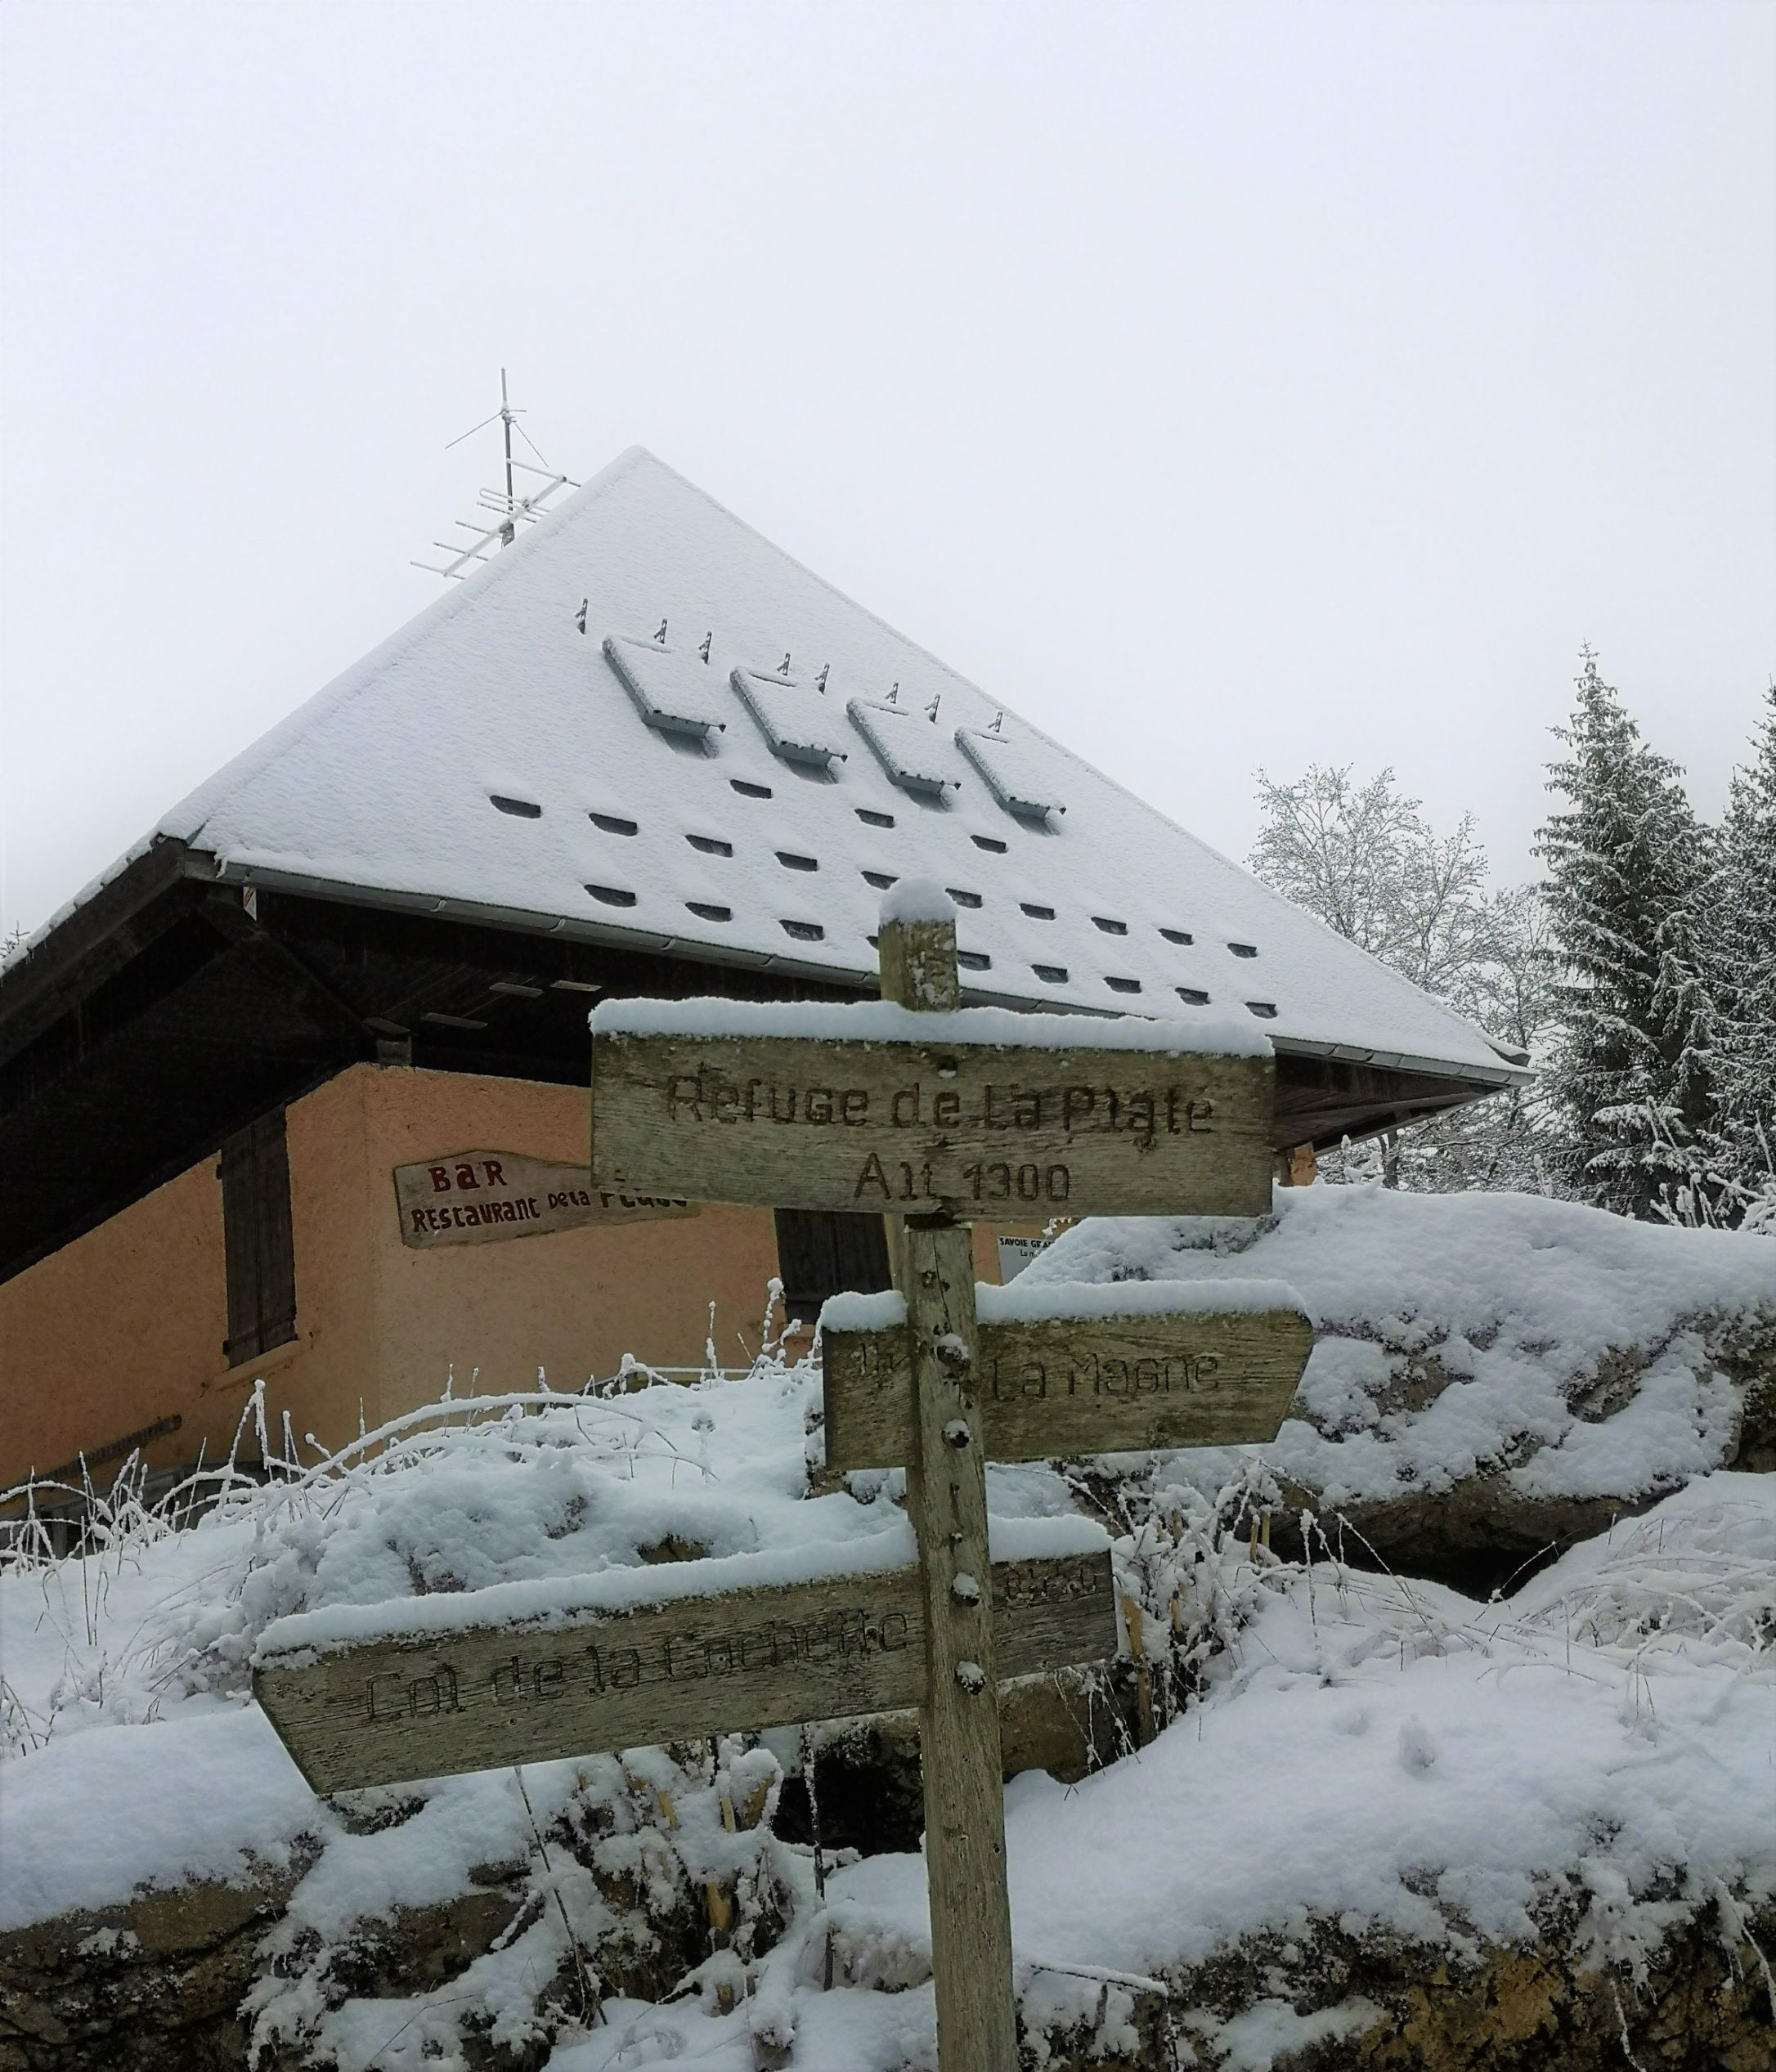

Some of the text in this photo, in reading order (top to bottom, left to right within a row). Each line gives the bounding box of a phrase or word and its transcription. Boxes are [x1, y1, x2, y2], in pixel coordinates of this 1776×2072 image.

[890, 1082, 960, 1129] de
[1063, 1084, 1214, 1135] Plate
[963, 1162, 1070, 1203] 1300
[999, 1237, 1028, 1248] SAVOIE
[993, 1358, 1047, 1402] La
